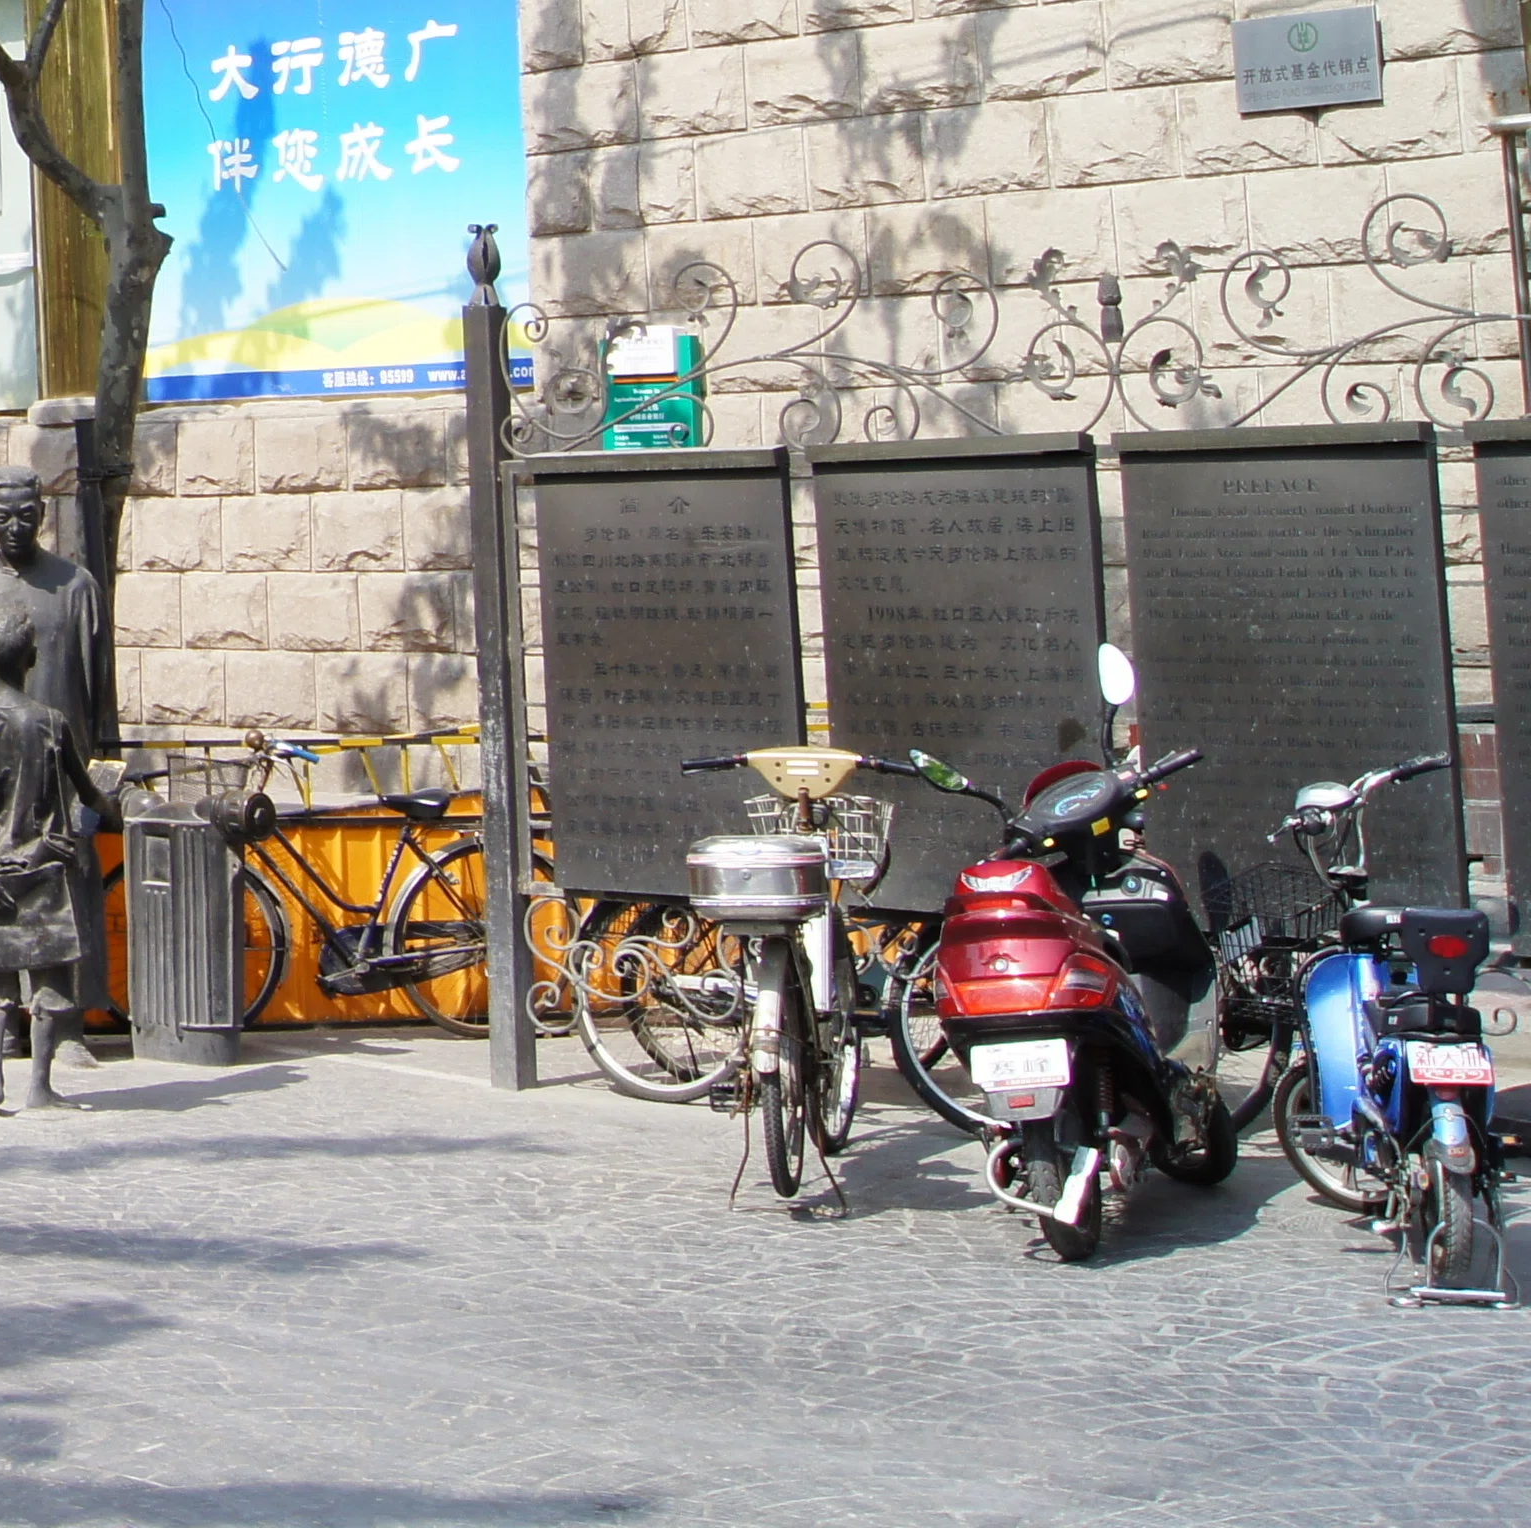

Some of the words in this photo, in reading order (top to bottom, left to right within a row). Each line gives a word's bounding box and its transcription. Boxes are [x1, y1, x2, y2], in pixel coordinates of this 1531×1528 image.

[207, 19, 458, 101] 大行德广
[1243, 56, 1370, 85] 开放式基金代销点
[207, 114, 460, 192] 伴您成长
[1222, 479, 1320, 494] PREFACE
